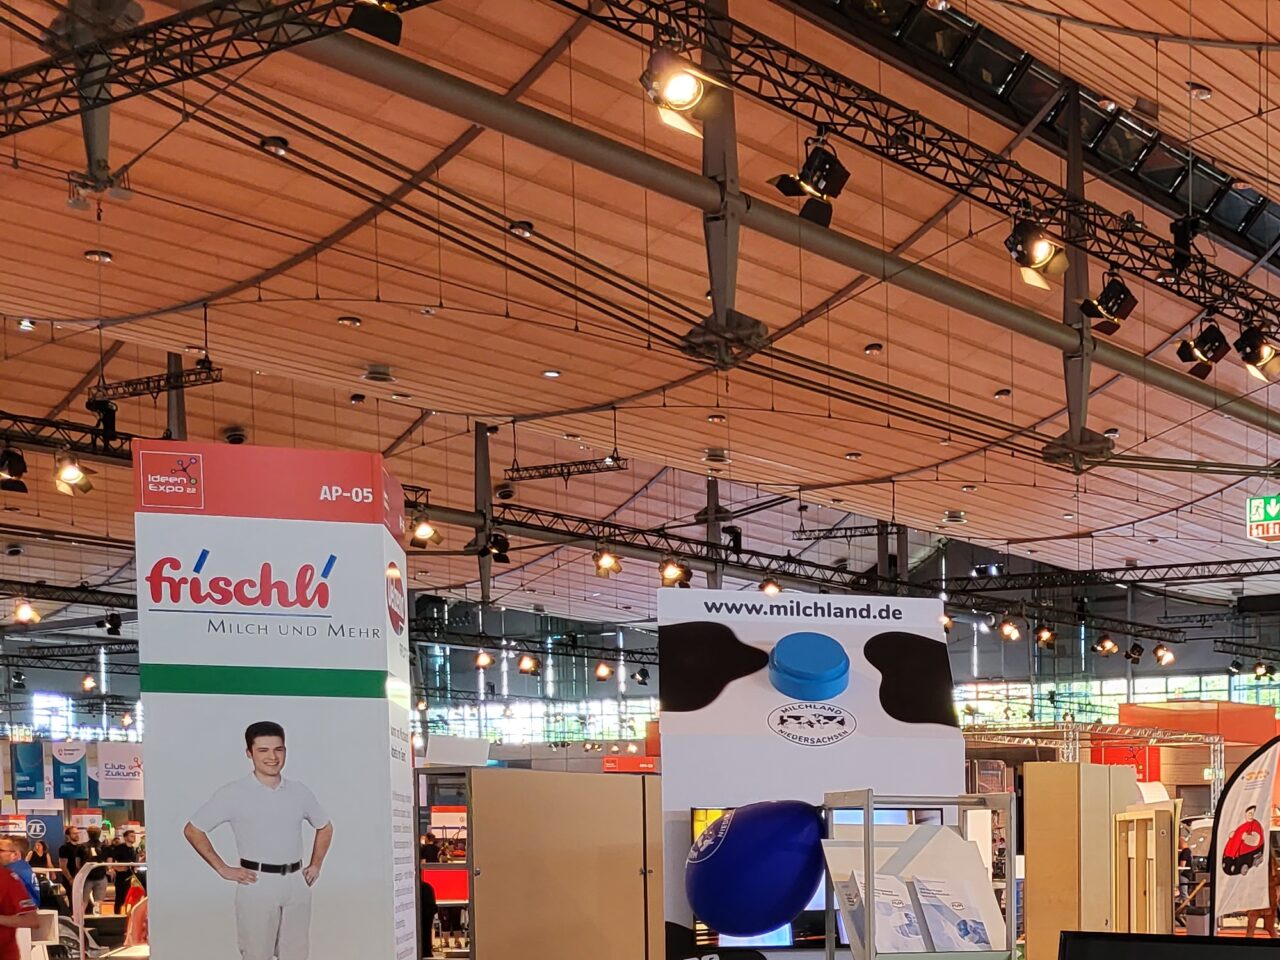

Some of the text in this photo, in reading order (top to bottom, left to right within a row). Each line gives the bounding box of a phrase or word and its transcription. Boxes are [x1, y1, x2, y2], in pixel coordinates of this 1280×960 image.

[148, 474, 187, 483] Ideen
[149, 483, 184, 493] Expo
[320, 486, 373, 502] AP-05
[704, 600, 903, 620] www.milchland.de
[208, 619, 380, 638] MILCH UND MEHR
[780, 702, 842, 715] MILCHLAND
[778, 729, 849, 744] NIEDERSACHSEN
[30, 824, 44, 833] ZF
